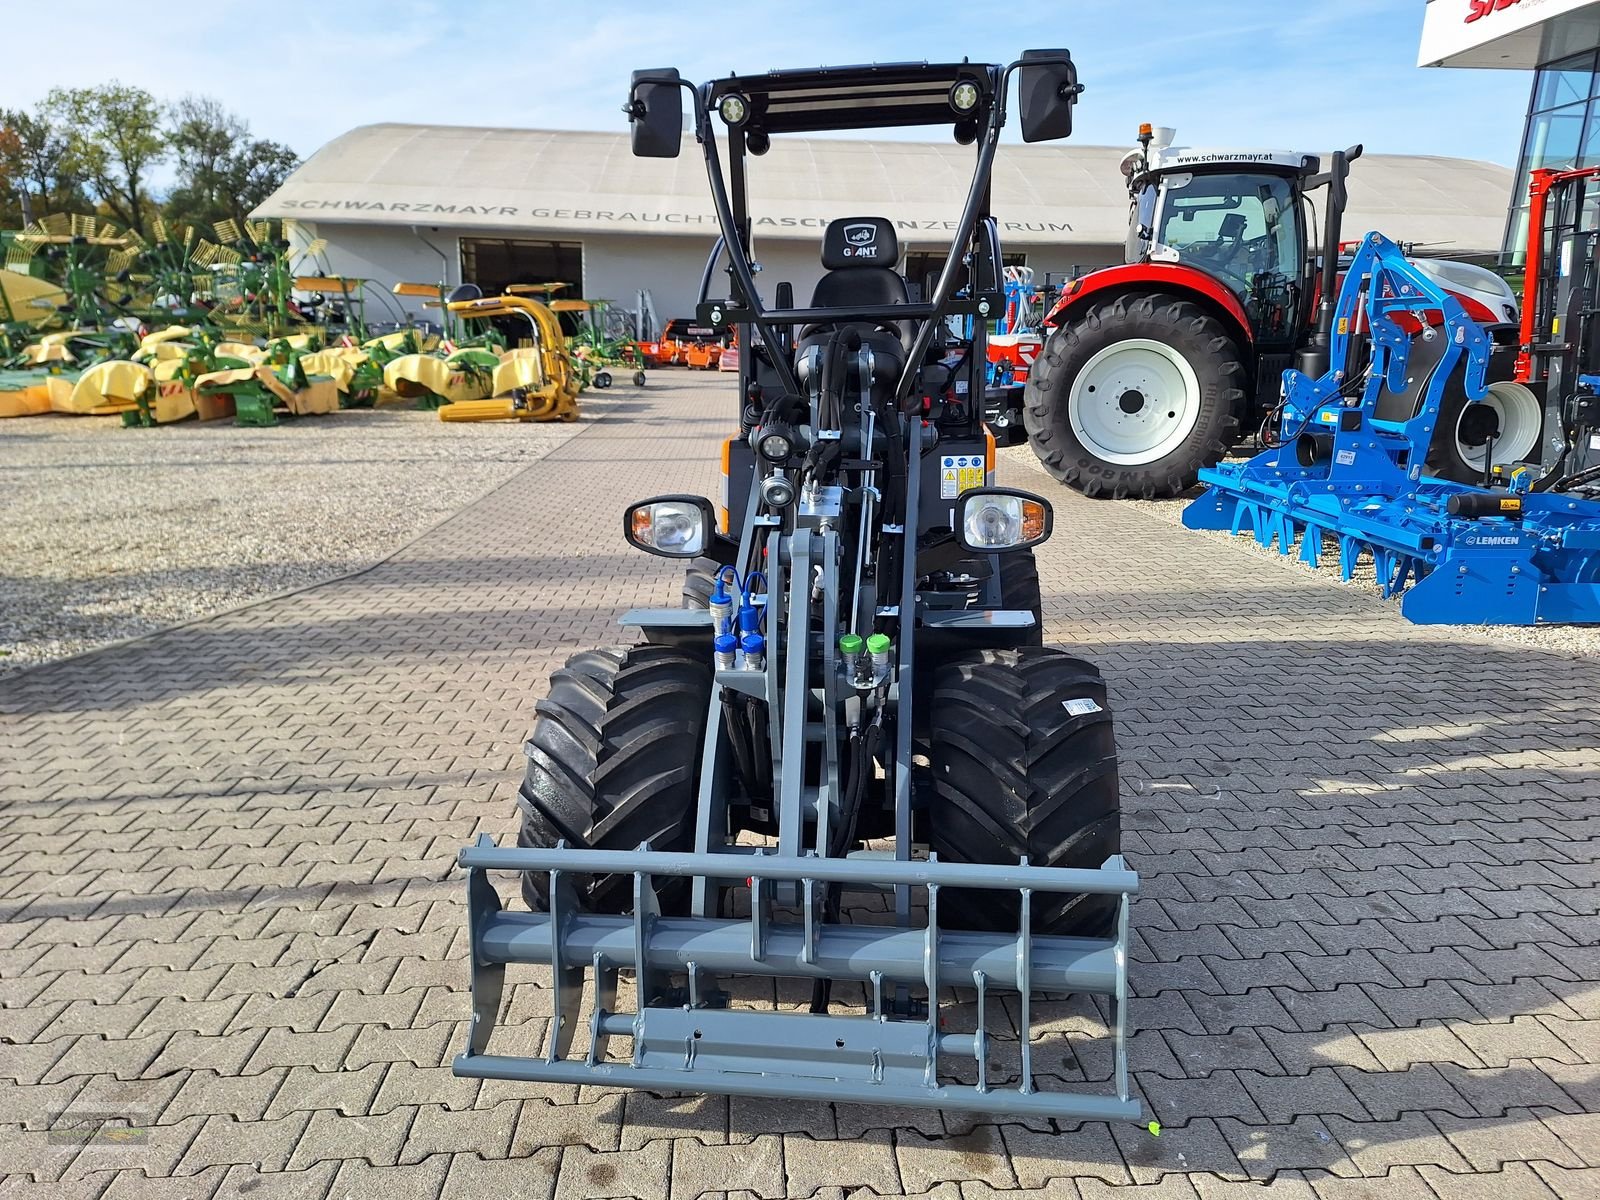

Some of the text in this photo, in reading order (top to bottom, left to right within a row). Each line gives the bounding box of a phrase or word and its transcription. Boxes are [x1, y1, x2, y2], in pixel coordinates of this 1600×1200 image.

[1177, 152, 1274, 163] www.schwarzmayr.at
[279, 199, 519, 216] SCHWARZMAYR
[843, 246, 877, 257] GIANT
[1475, 536, 1519, 546] LEMKEN
